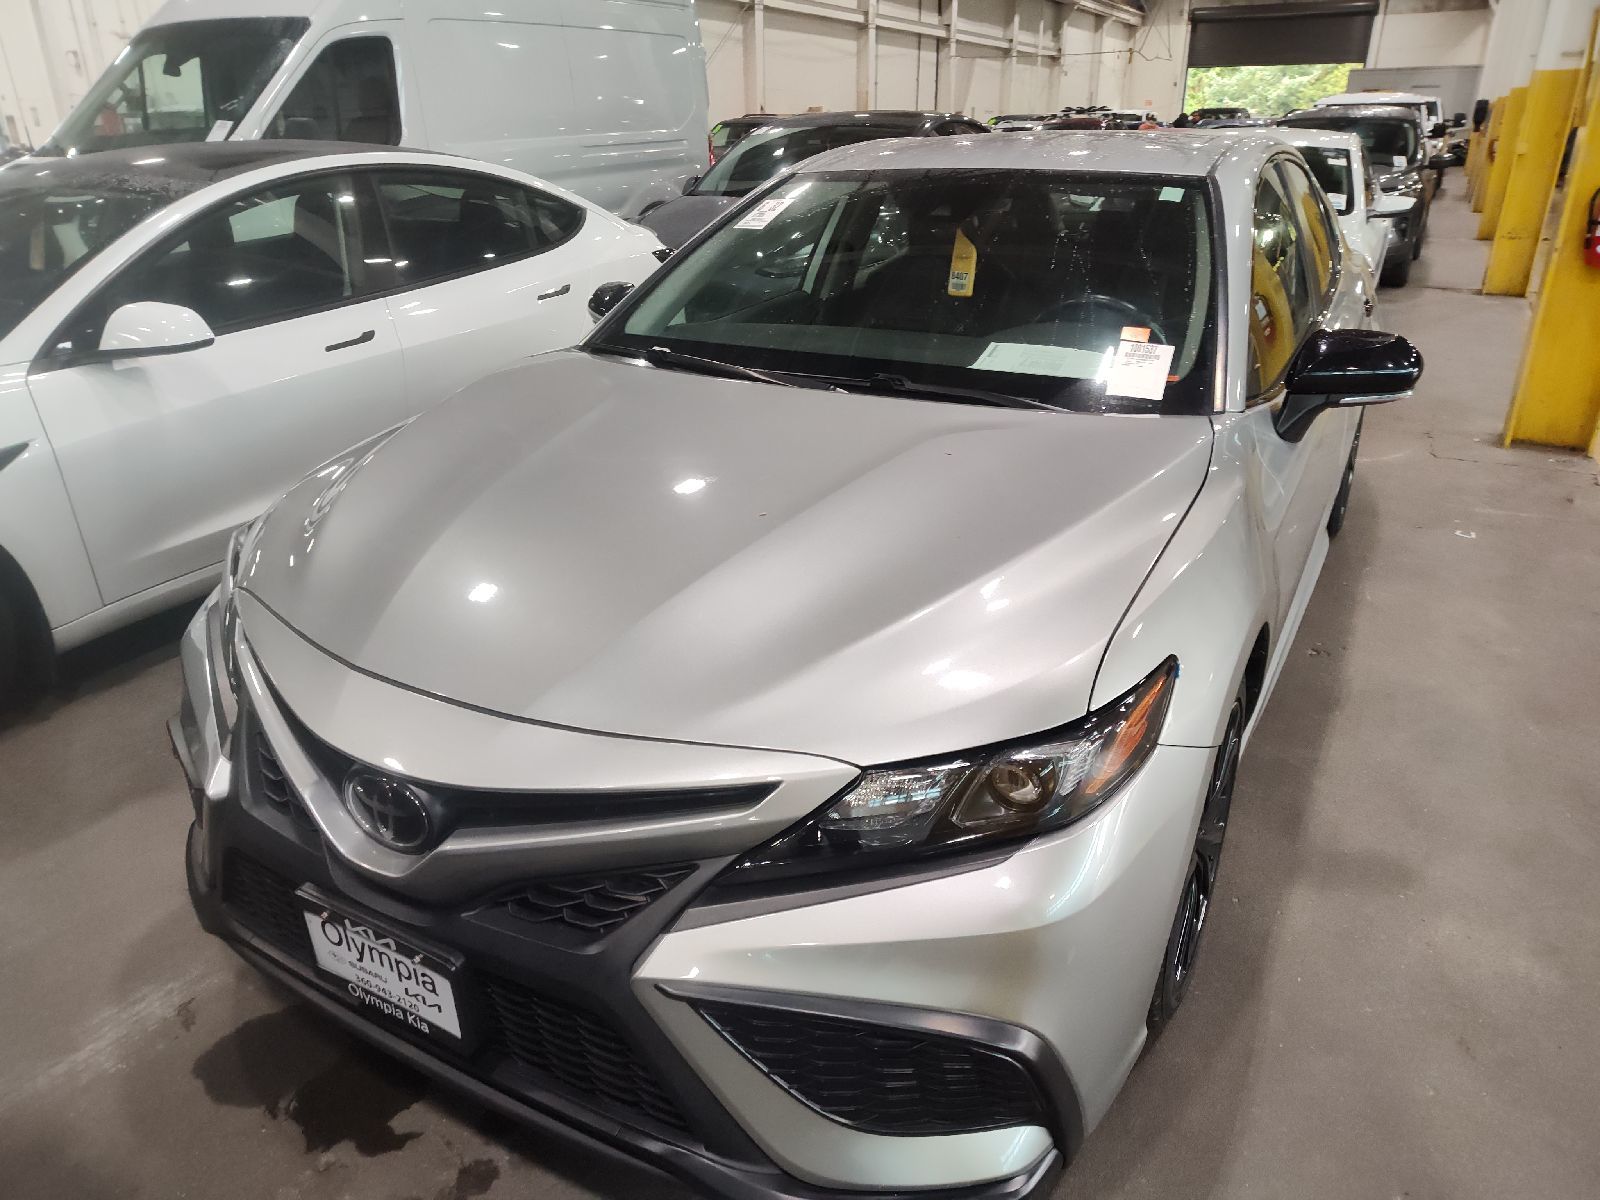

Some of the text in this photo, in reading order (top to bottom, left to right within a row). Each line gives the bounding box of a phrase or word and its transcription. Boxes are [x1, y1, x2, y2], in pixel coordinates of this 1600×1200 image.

[321, 920, 439, 996] Olympia
[348, 961, 388, 984] SUBARU
[348, 983, 430, 1034] Olympia Kia
